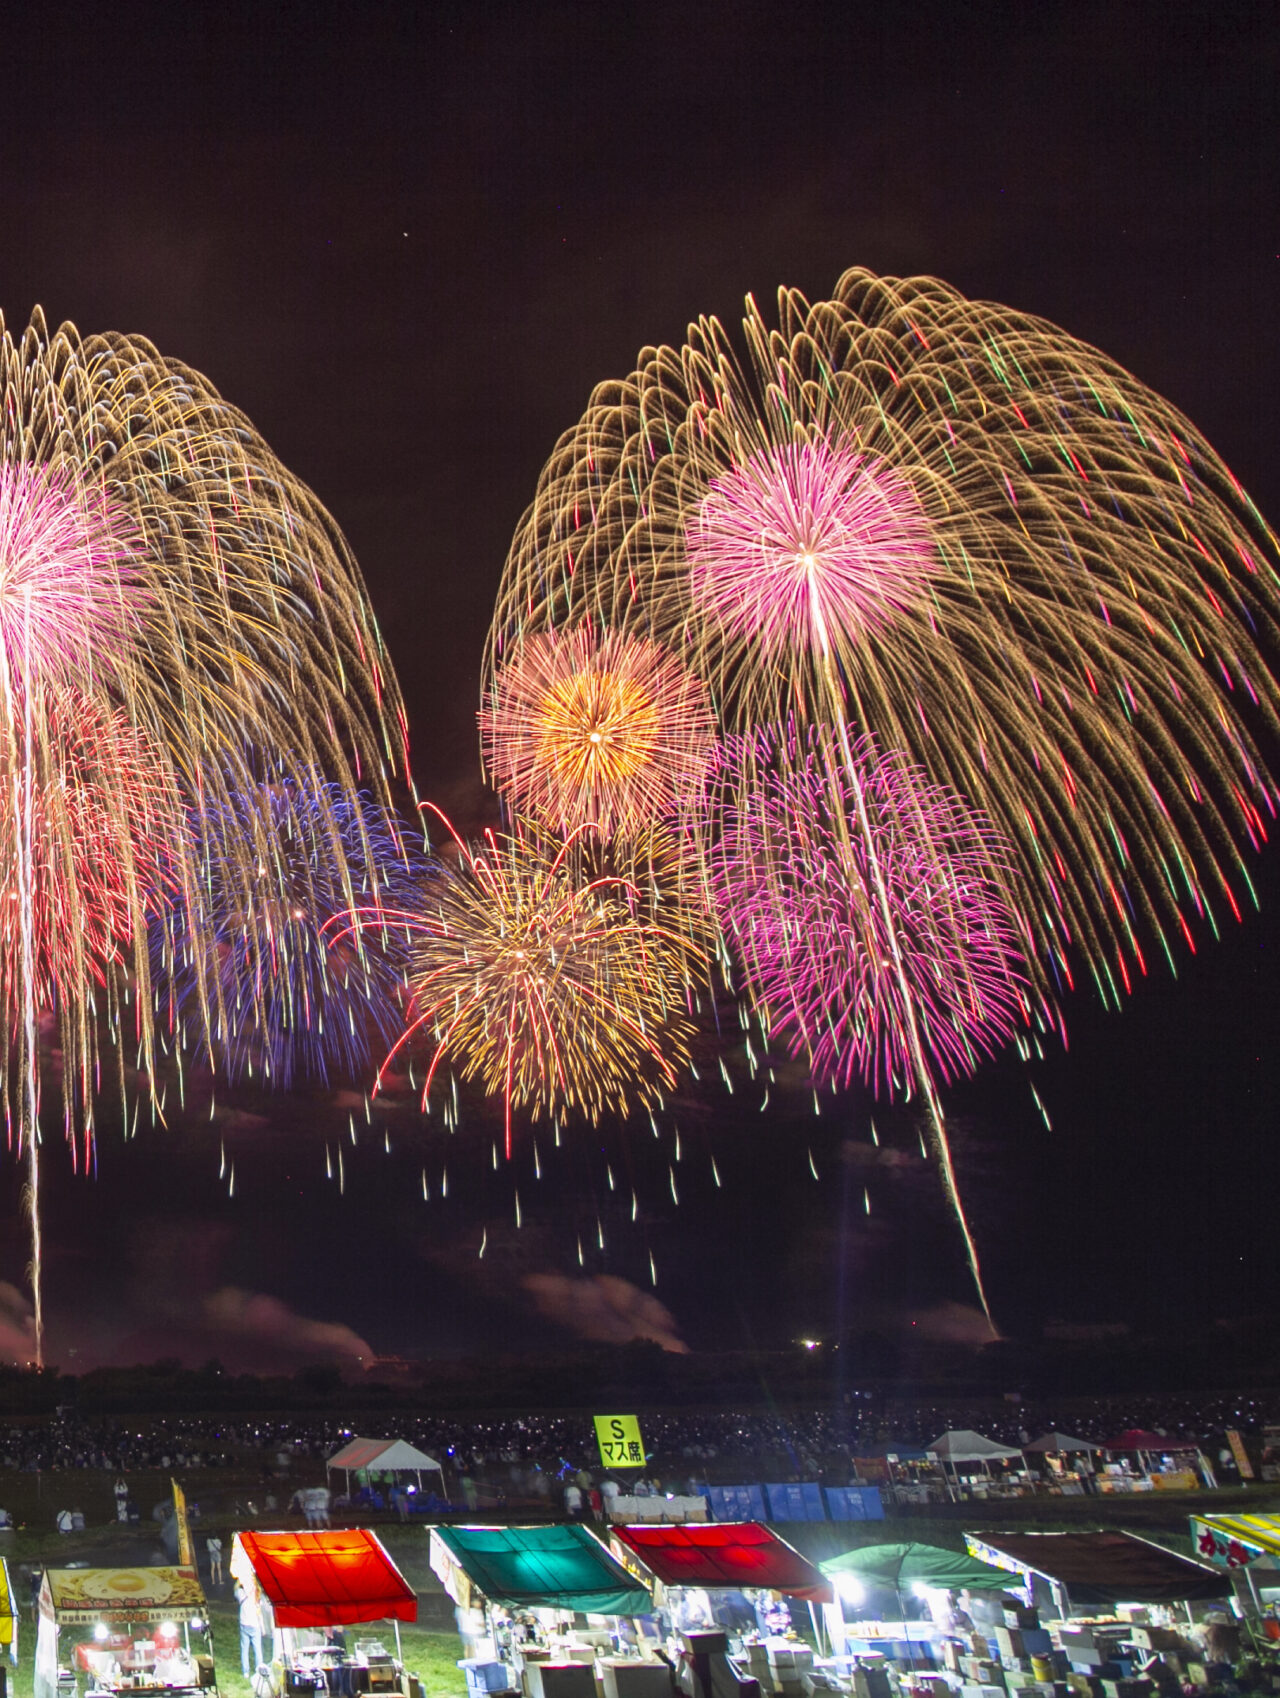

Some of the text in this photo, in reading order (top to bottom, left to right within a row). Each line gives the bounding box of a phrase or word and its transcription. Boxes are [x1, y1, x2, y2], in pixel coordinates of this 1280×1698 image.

[610, 1419, 625, 1440] S
[602, 1441, 642, 1462] マス席
